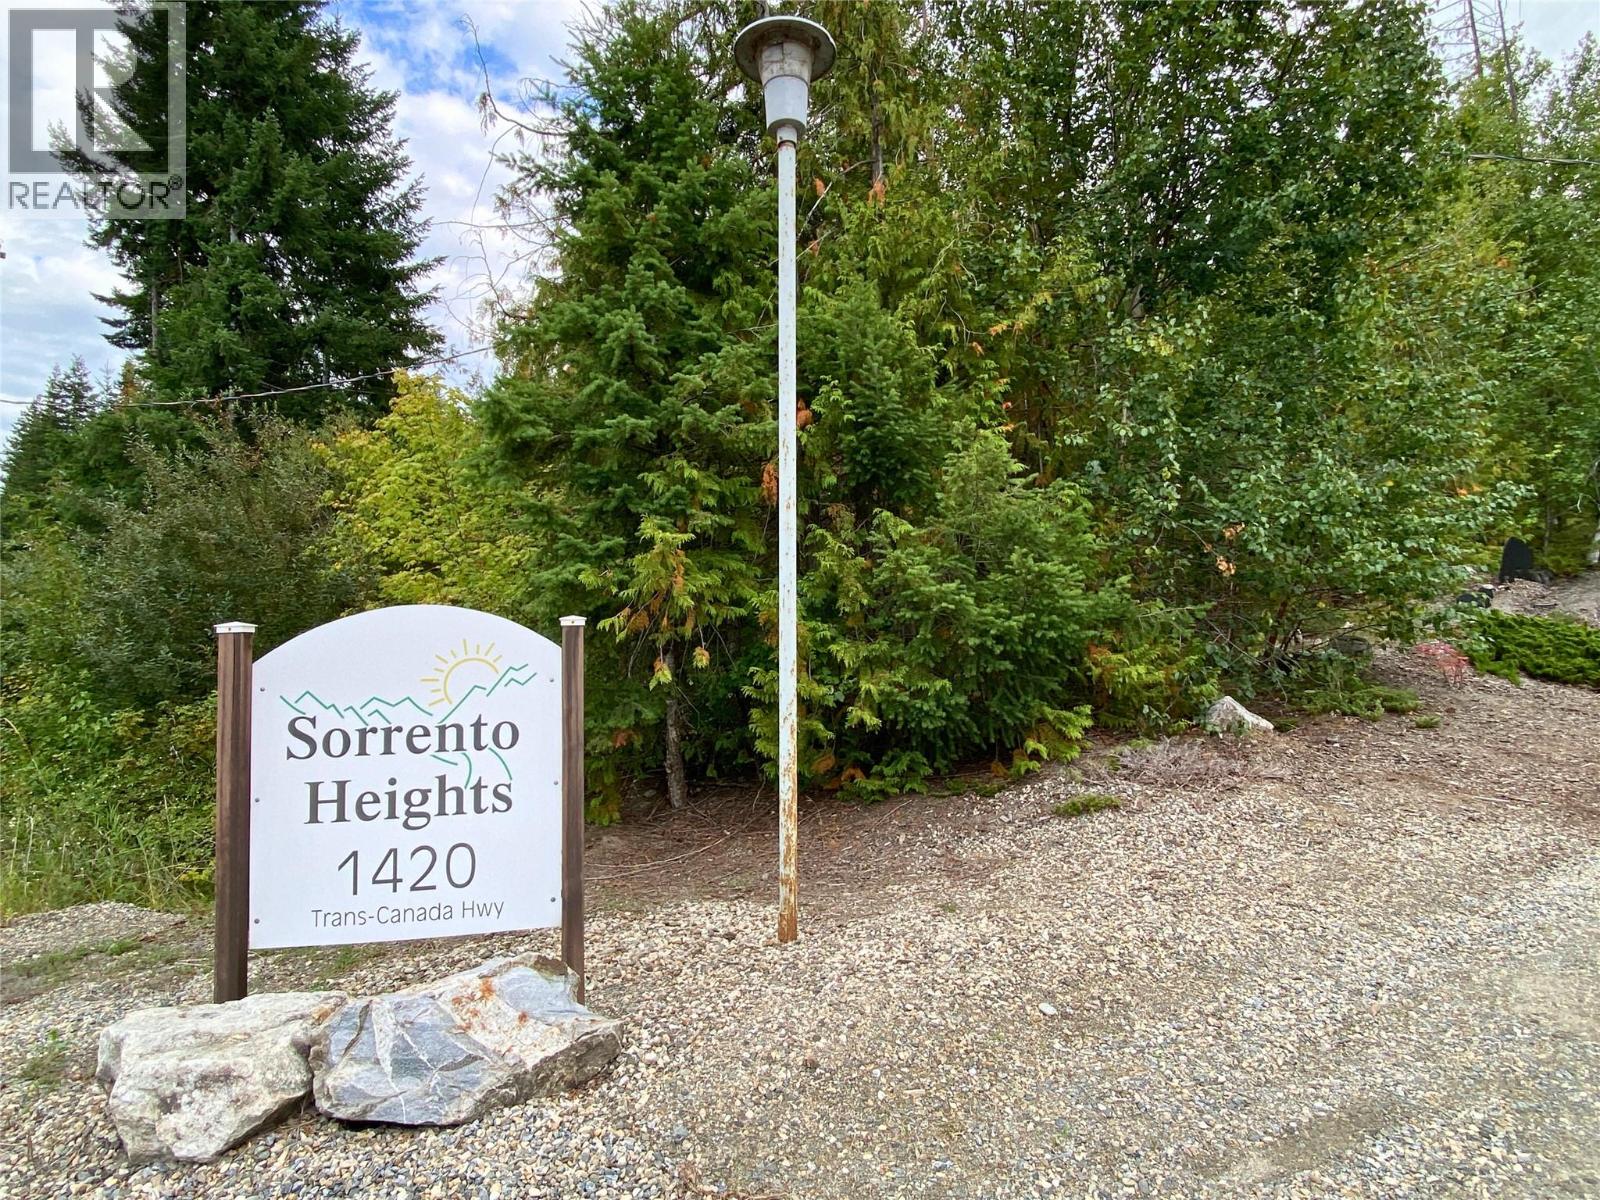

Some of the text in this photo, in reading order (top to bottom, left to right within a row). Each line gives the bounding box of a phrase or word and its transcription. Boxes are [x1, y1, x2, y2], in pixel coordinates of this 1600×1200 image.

[286, 713, 520, 761] Sorrento
[303, 773, 513, 831] Heights
[336, 842, 477, 896] 1420
[311, 899, 505, 928] Trans-Canada Hwy
